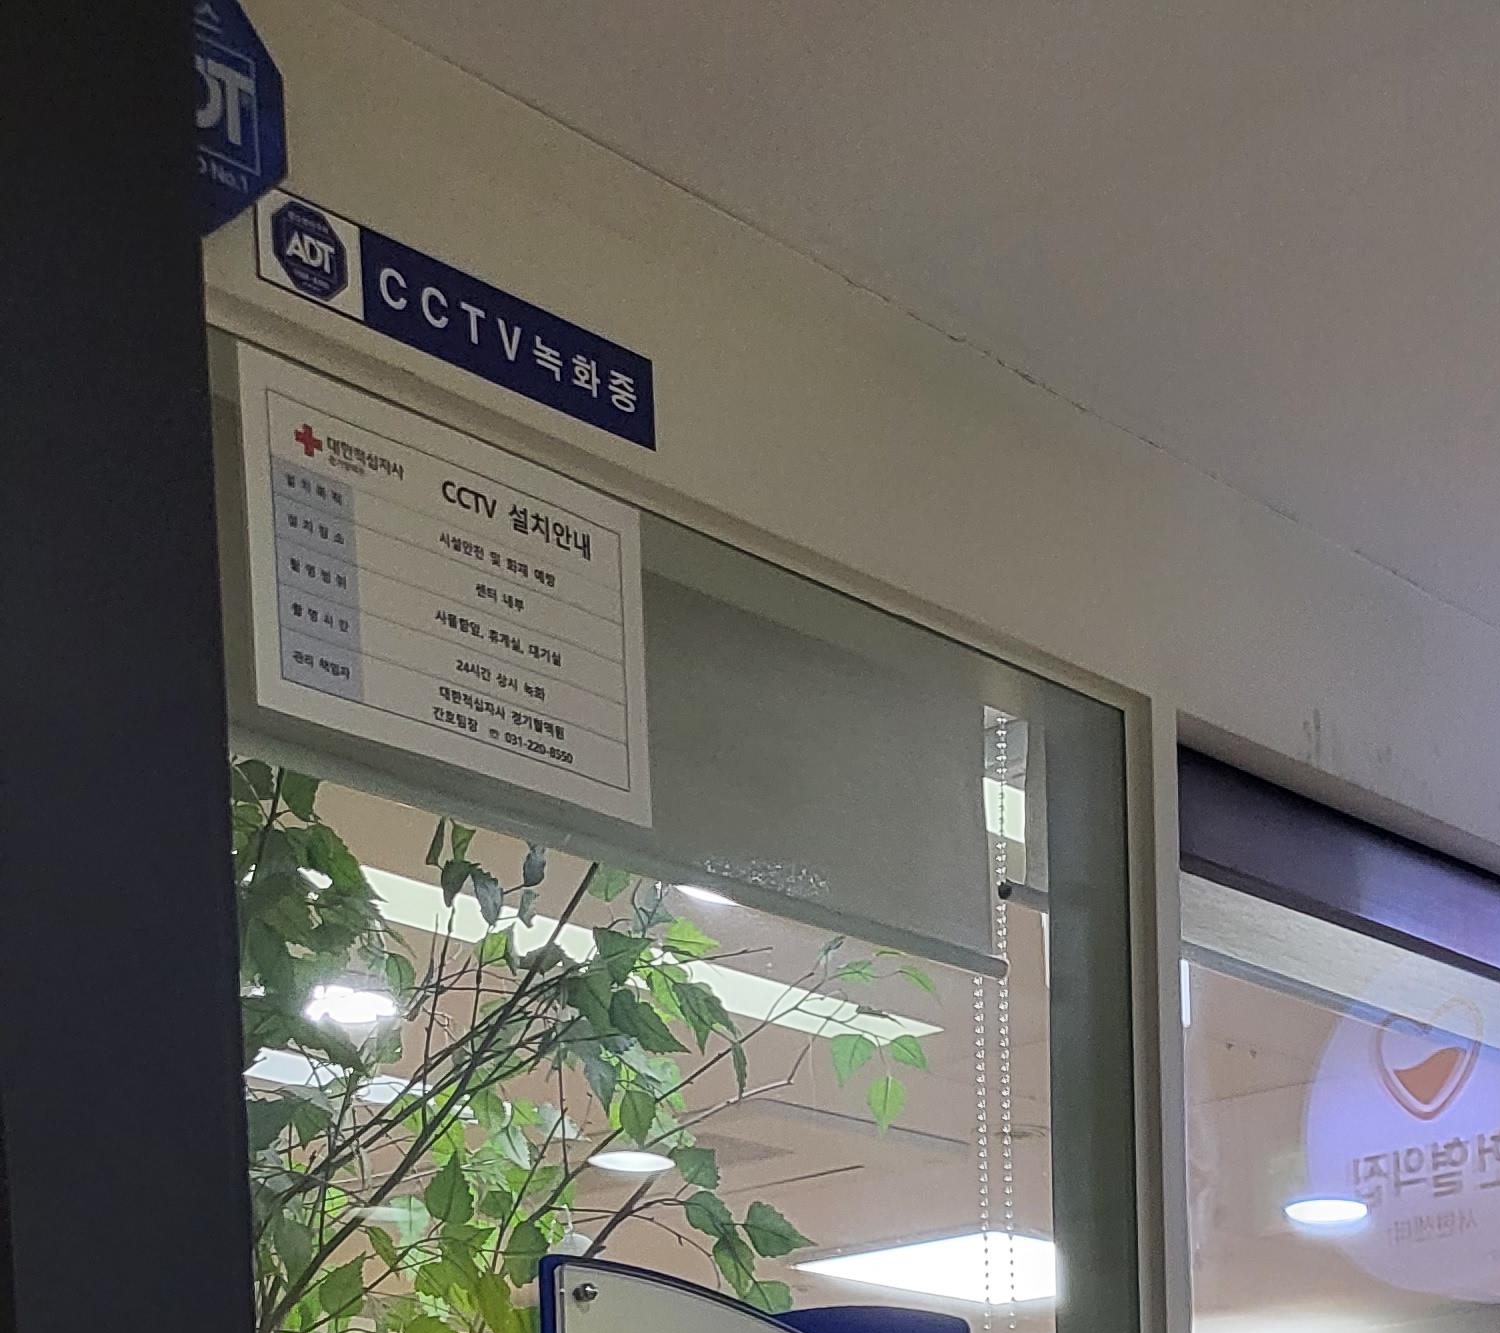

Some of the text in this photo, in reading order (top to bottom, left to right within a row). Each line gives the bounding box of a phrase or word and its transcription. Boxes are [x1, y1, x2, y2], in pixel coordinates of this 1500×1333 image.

[195, 54, 256, 146] DT
[285, 230, 336, 275] ADT
[326, 436, 405, 481] 대한적십자사
[441, 480, 592, 562] CCTV 설치안내
[455, 659, 492, 683] 24시간
[496, 672, 519, 693] 상시
[528, 643, 562, 668] 대기실
[439, 685, 506, 721] 대한적십자사
